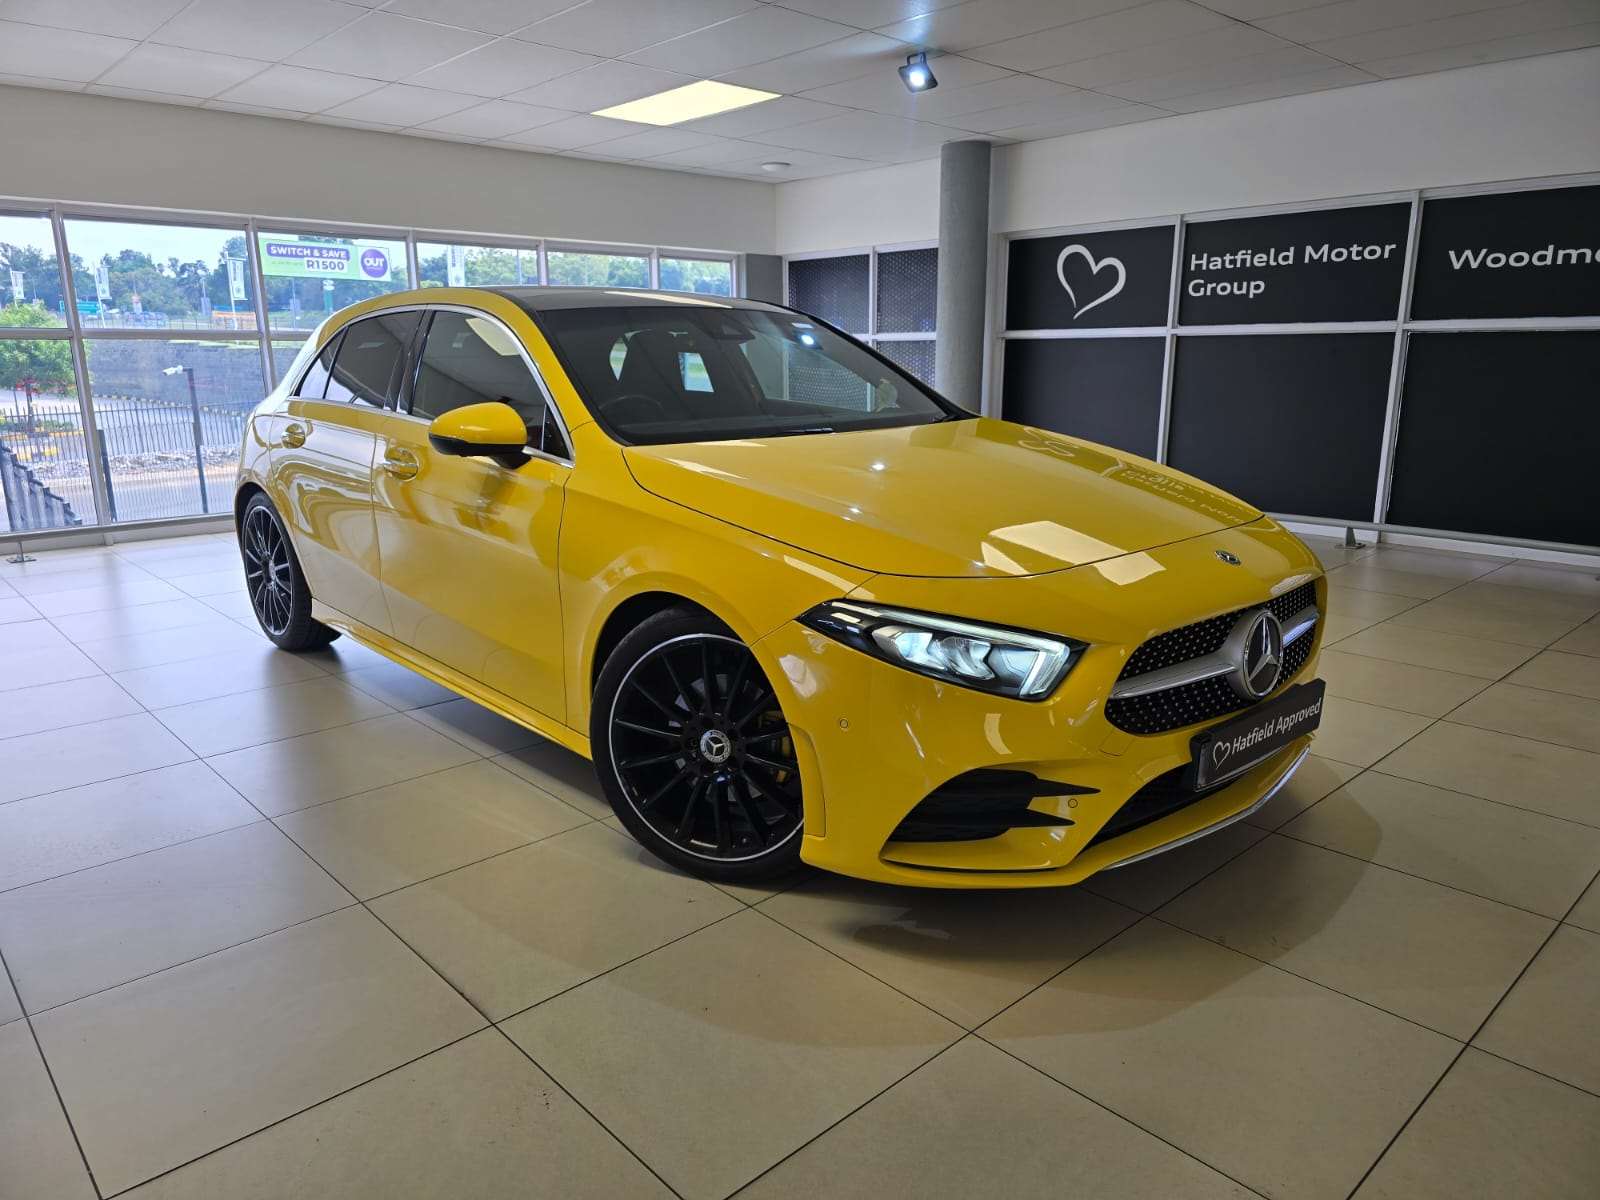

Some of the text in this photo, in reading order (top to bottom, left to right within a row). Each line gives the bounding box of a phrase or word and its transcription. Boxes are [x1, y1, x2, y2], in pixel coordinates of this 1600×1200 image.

[270, 246, 347, 259] SWITCH & SAVE
[363, 257, 385, 267] OUT
[1190, 244, 1397, 271] Hatfield Motor
[1448, 244, 1600, 270] Woodm
[306, 259, 345, 270] R1500
[1188, 279, 1265, 298] Group
[1232, 697, 1322, 755] Hatfield Approved
